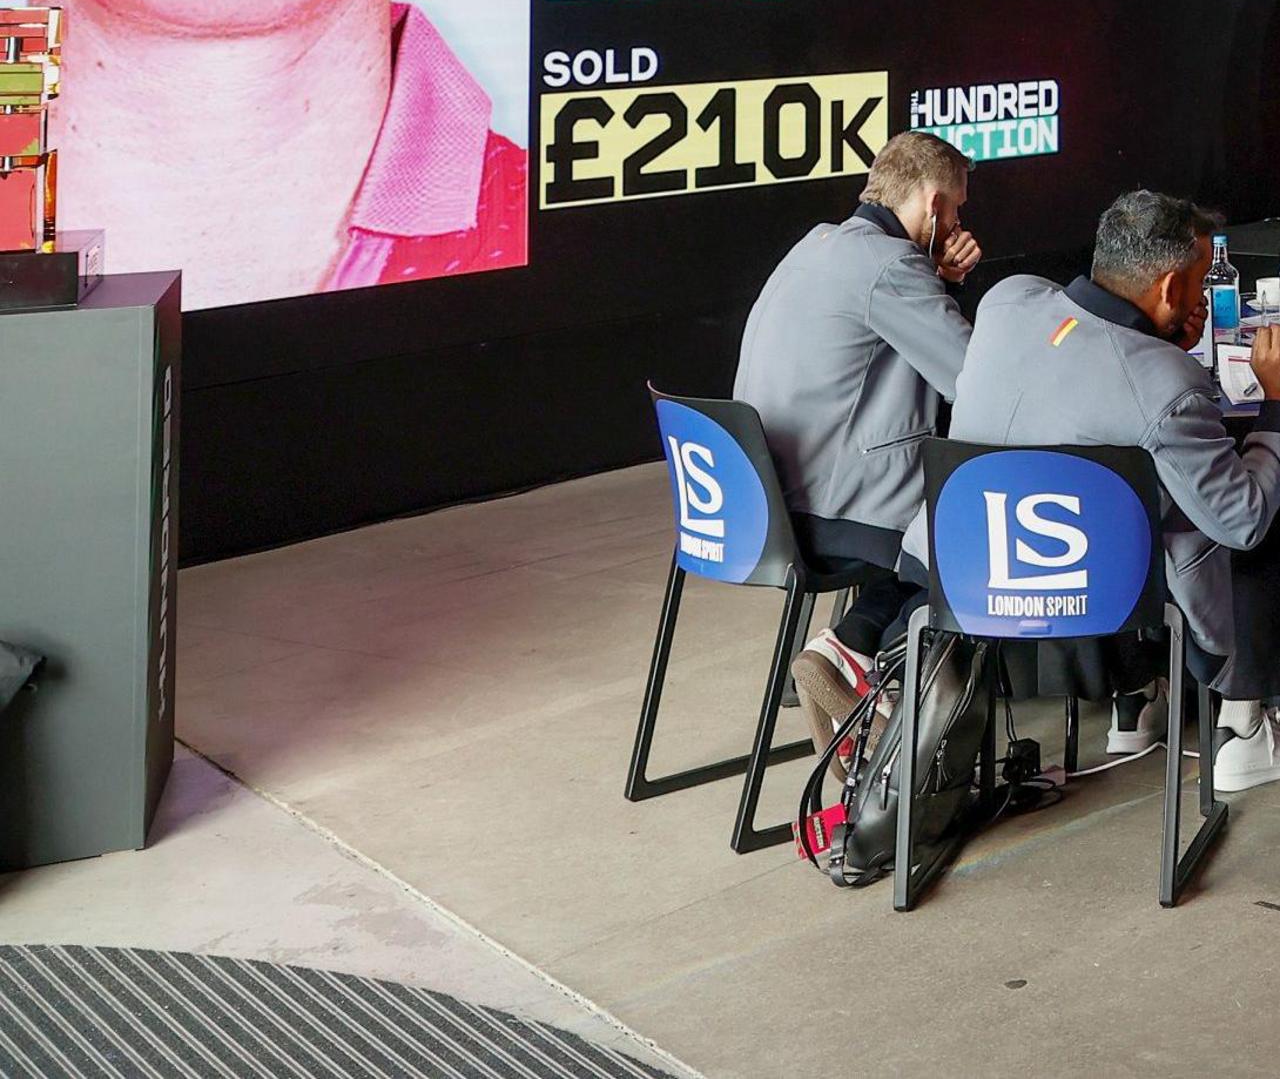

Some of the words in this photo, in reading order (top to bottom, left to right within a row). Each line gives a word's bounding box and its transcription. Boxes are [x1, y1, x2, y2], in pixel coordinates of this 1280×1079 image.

[542, 46, 659, 88] SOLD
[910, 80, 1059, 128] HUNDRED
[546, 82, 883, 205] £210K
[930, 115, 1059, 160] CTION
[668, 435, 725, 539] LS
[983, 491, 1089, 591] LS
[987, 594, 1045, 617] LONDON
[1046, 594, 1088, 616] SPIRIT
